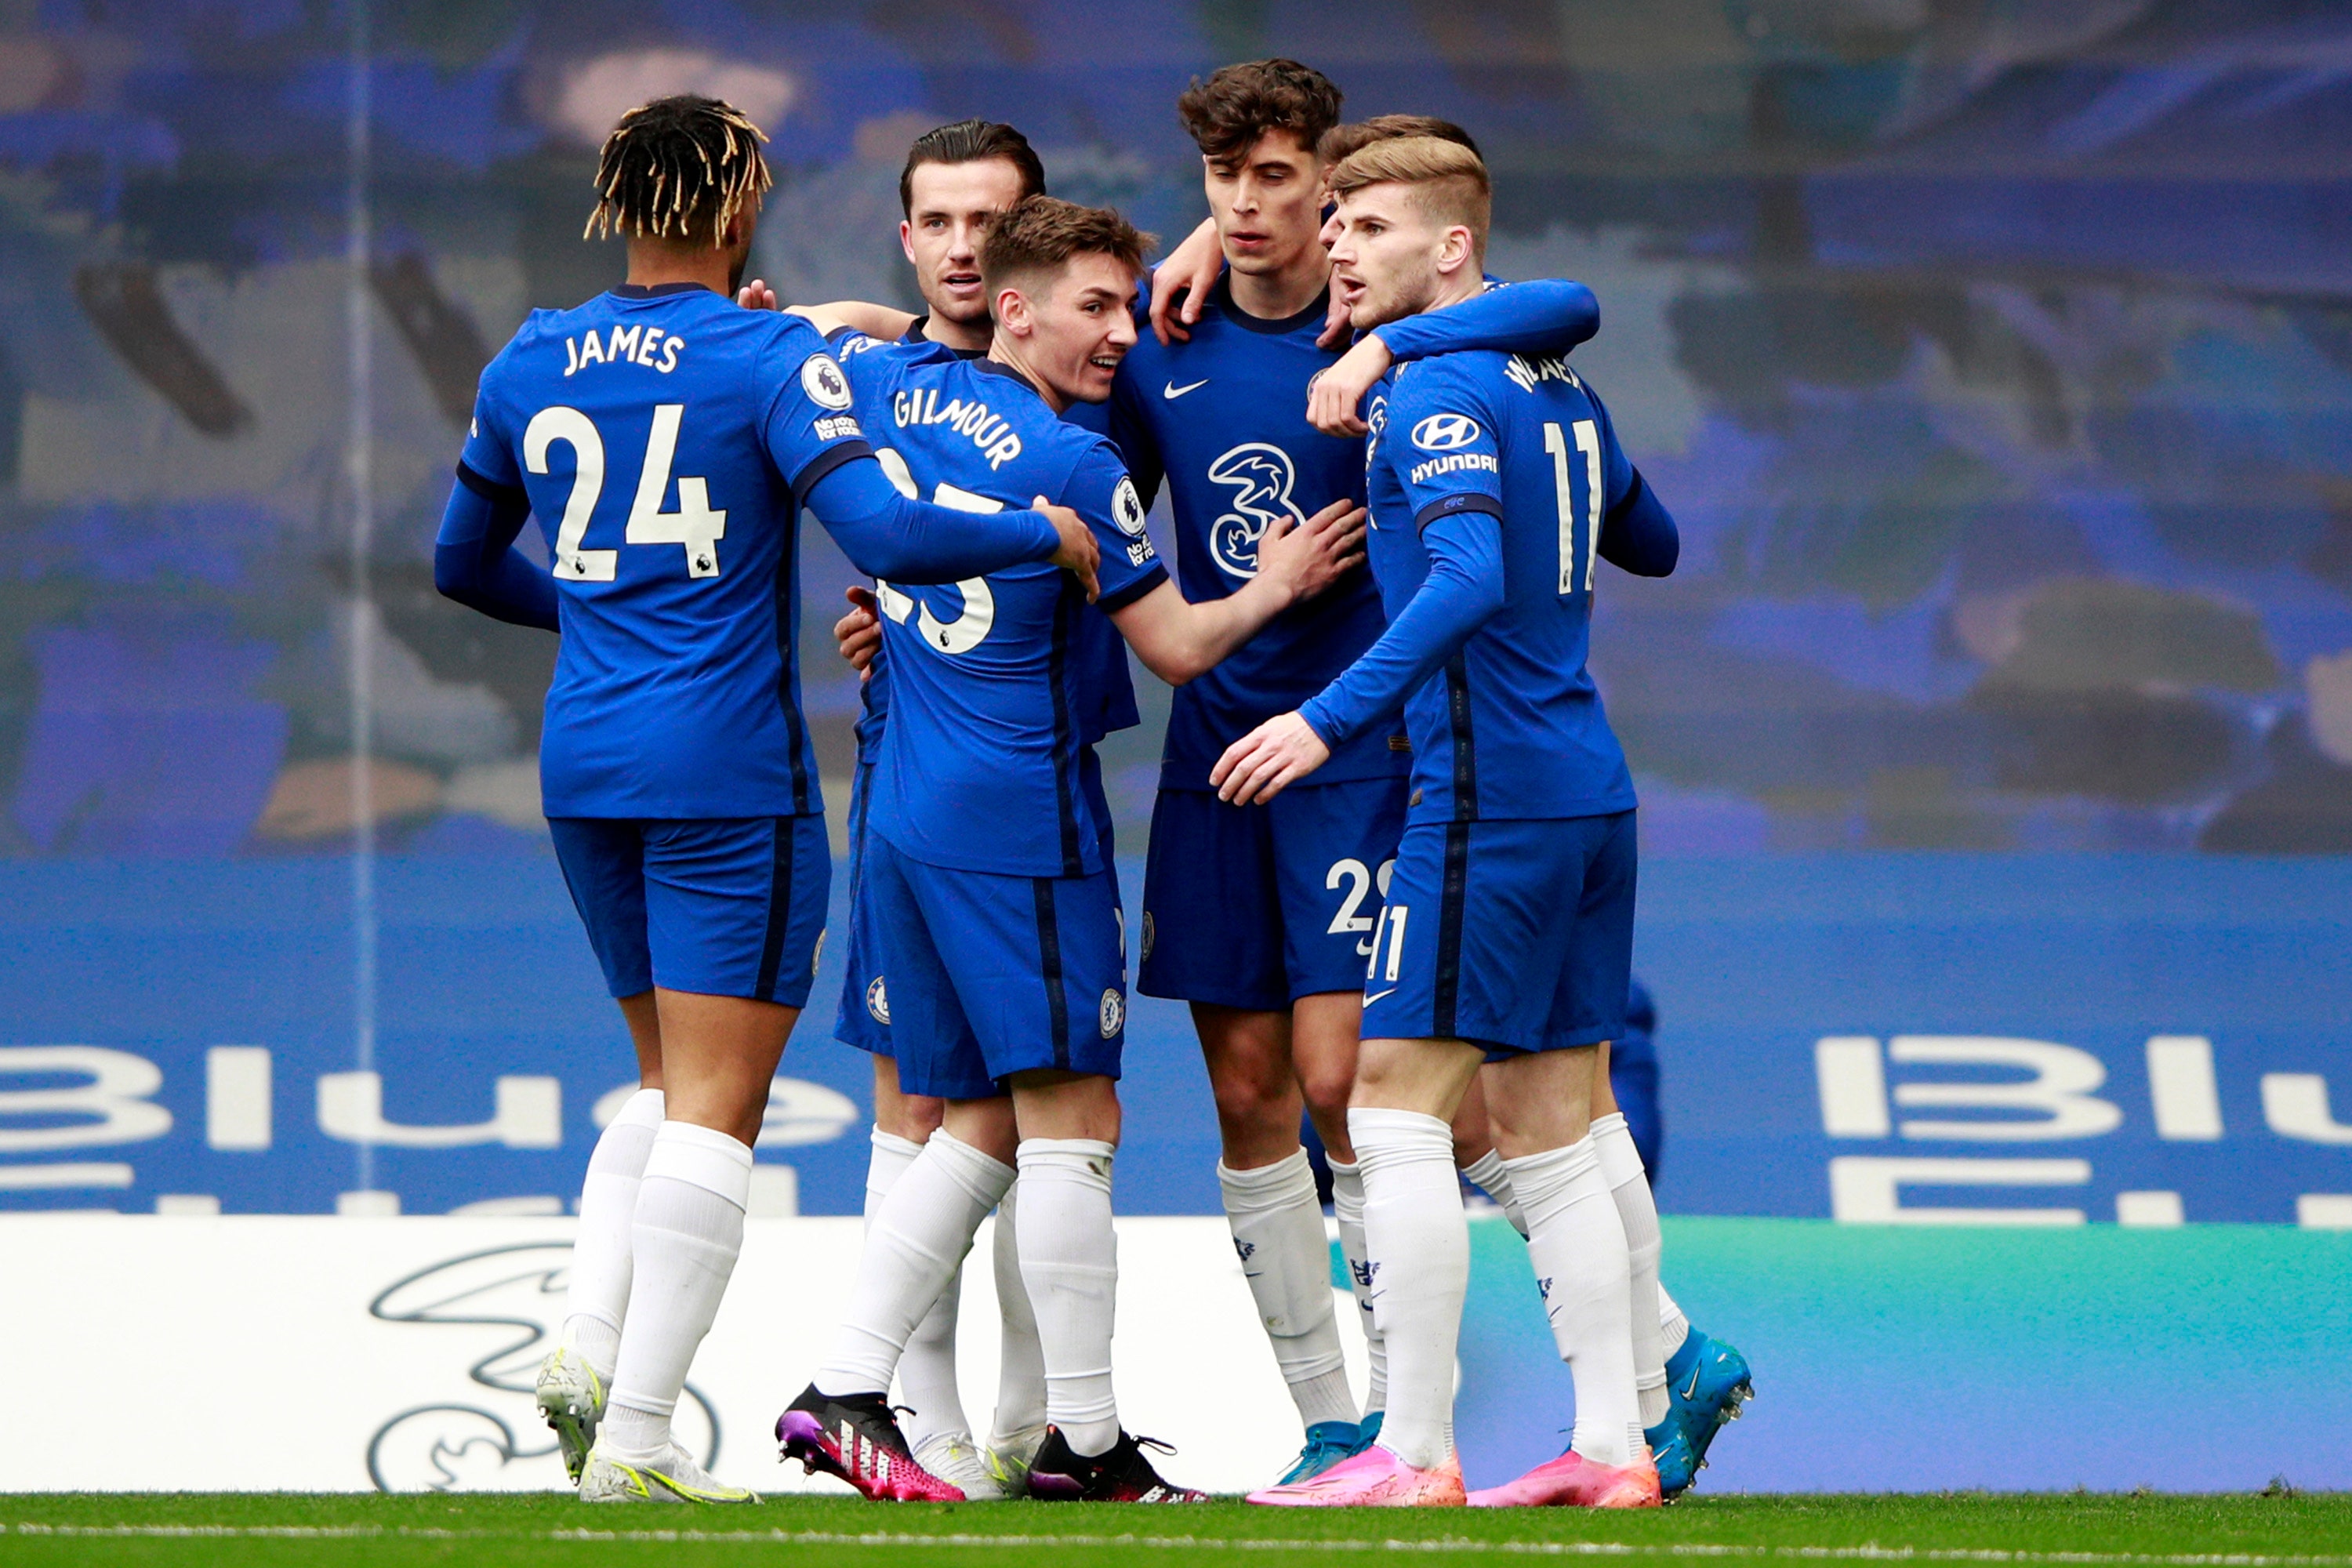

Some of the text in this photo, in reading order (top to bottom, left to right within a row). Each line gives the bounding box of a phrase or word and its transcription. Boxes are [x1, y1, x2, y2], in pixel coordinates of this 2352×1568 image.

[564, 325, 685, 377] JAMES
[894, 388, 1022, 471] GILMOUR
[1411, 453, 1497, 485] HYUNDAI
[522, 403, 728, 582] 24
[1543, 419, 1602, 595] 11
